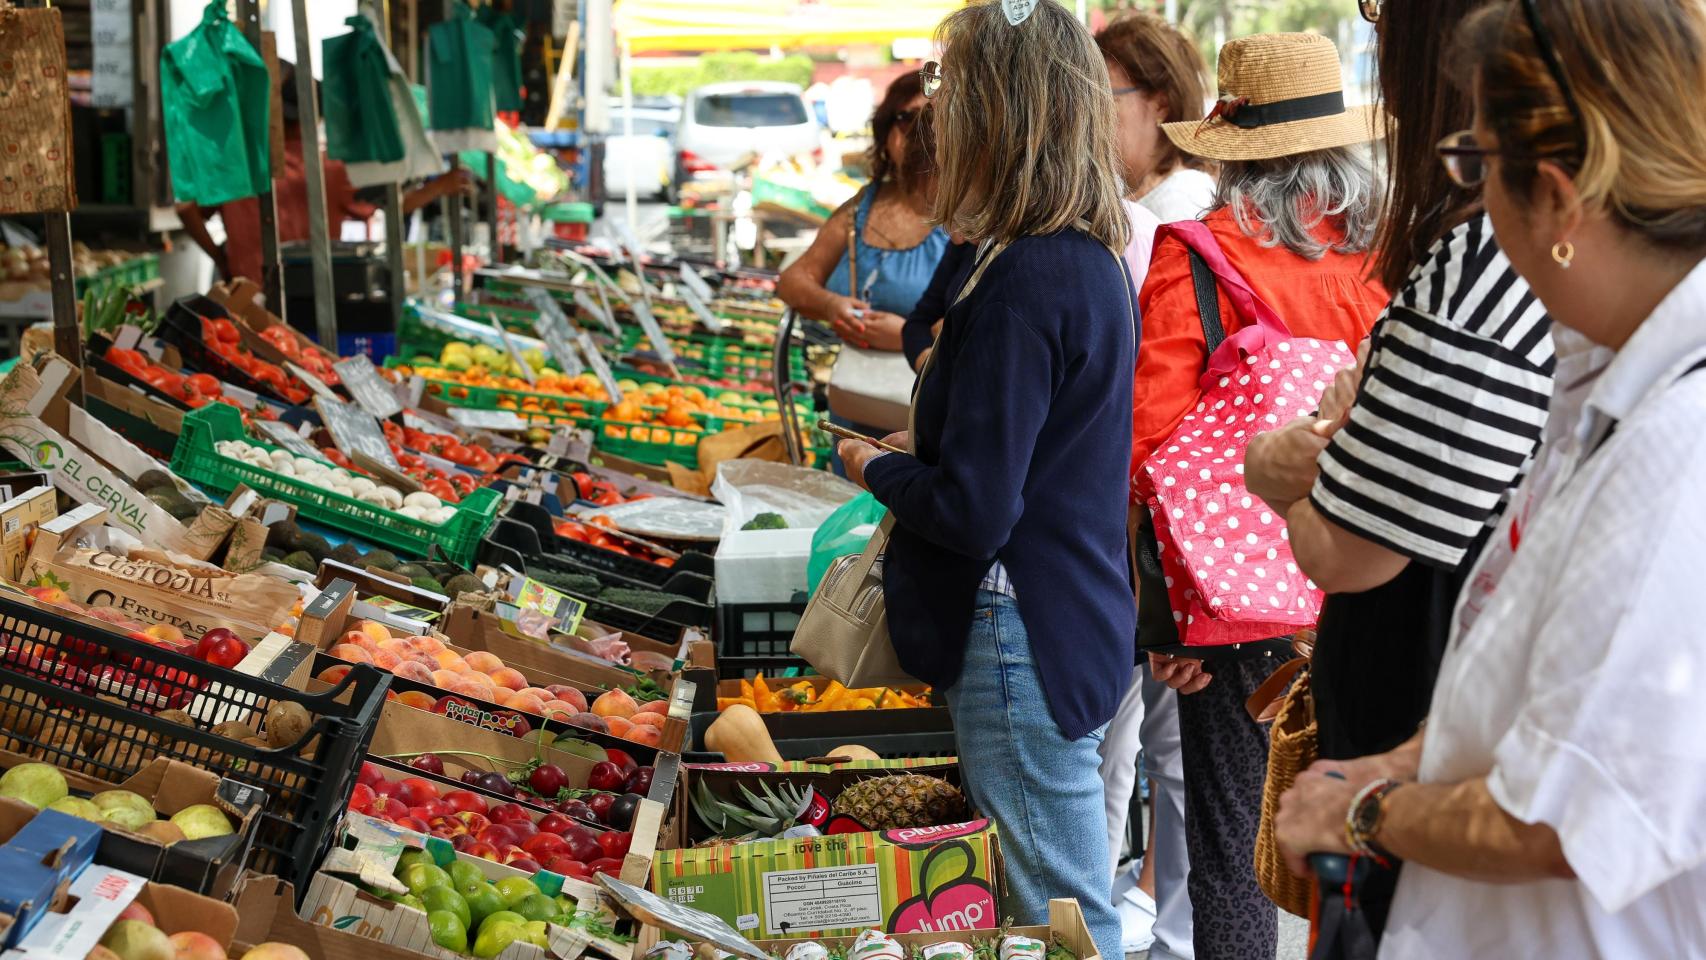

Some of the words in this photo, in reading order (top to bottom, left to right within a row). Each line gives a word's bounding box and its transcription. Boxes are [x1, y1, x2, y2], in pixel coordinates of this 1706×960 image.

[62, 458, 82, 482] EL
[86, 476, 148, 531] CERVAL
[89, 552, 215, 600] CUSTODIA
[118, 595, 208, 634] FRUTAS
[447, 701, 480, 718] Frutas
[825, 838, 848, 851] the
[908, 903, 983, 932] lump
